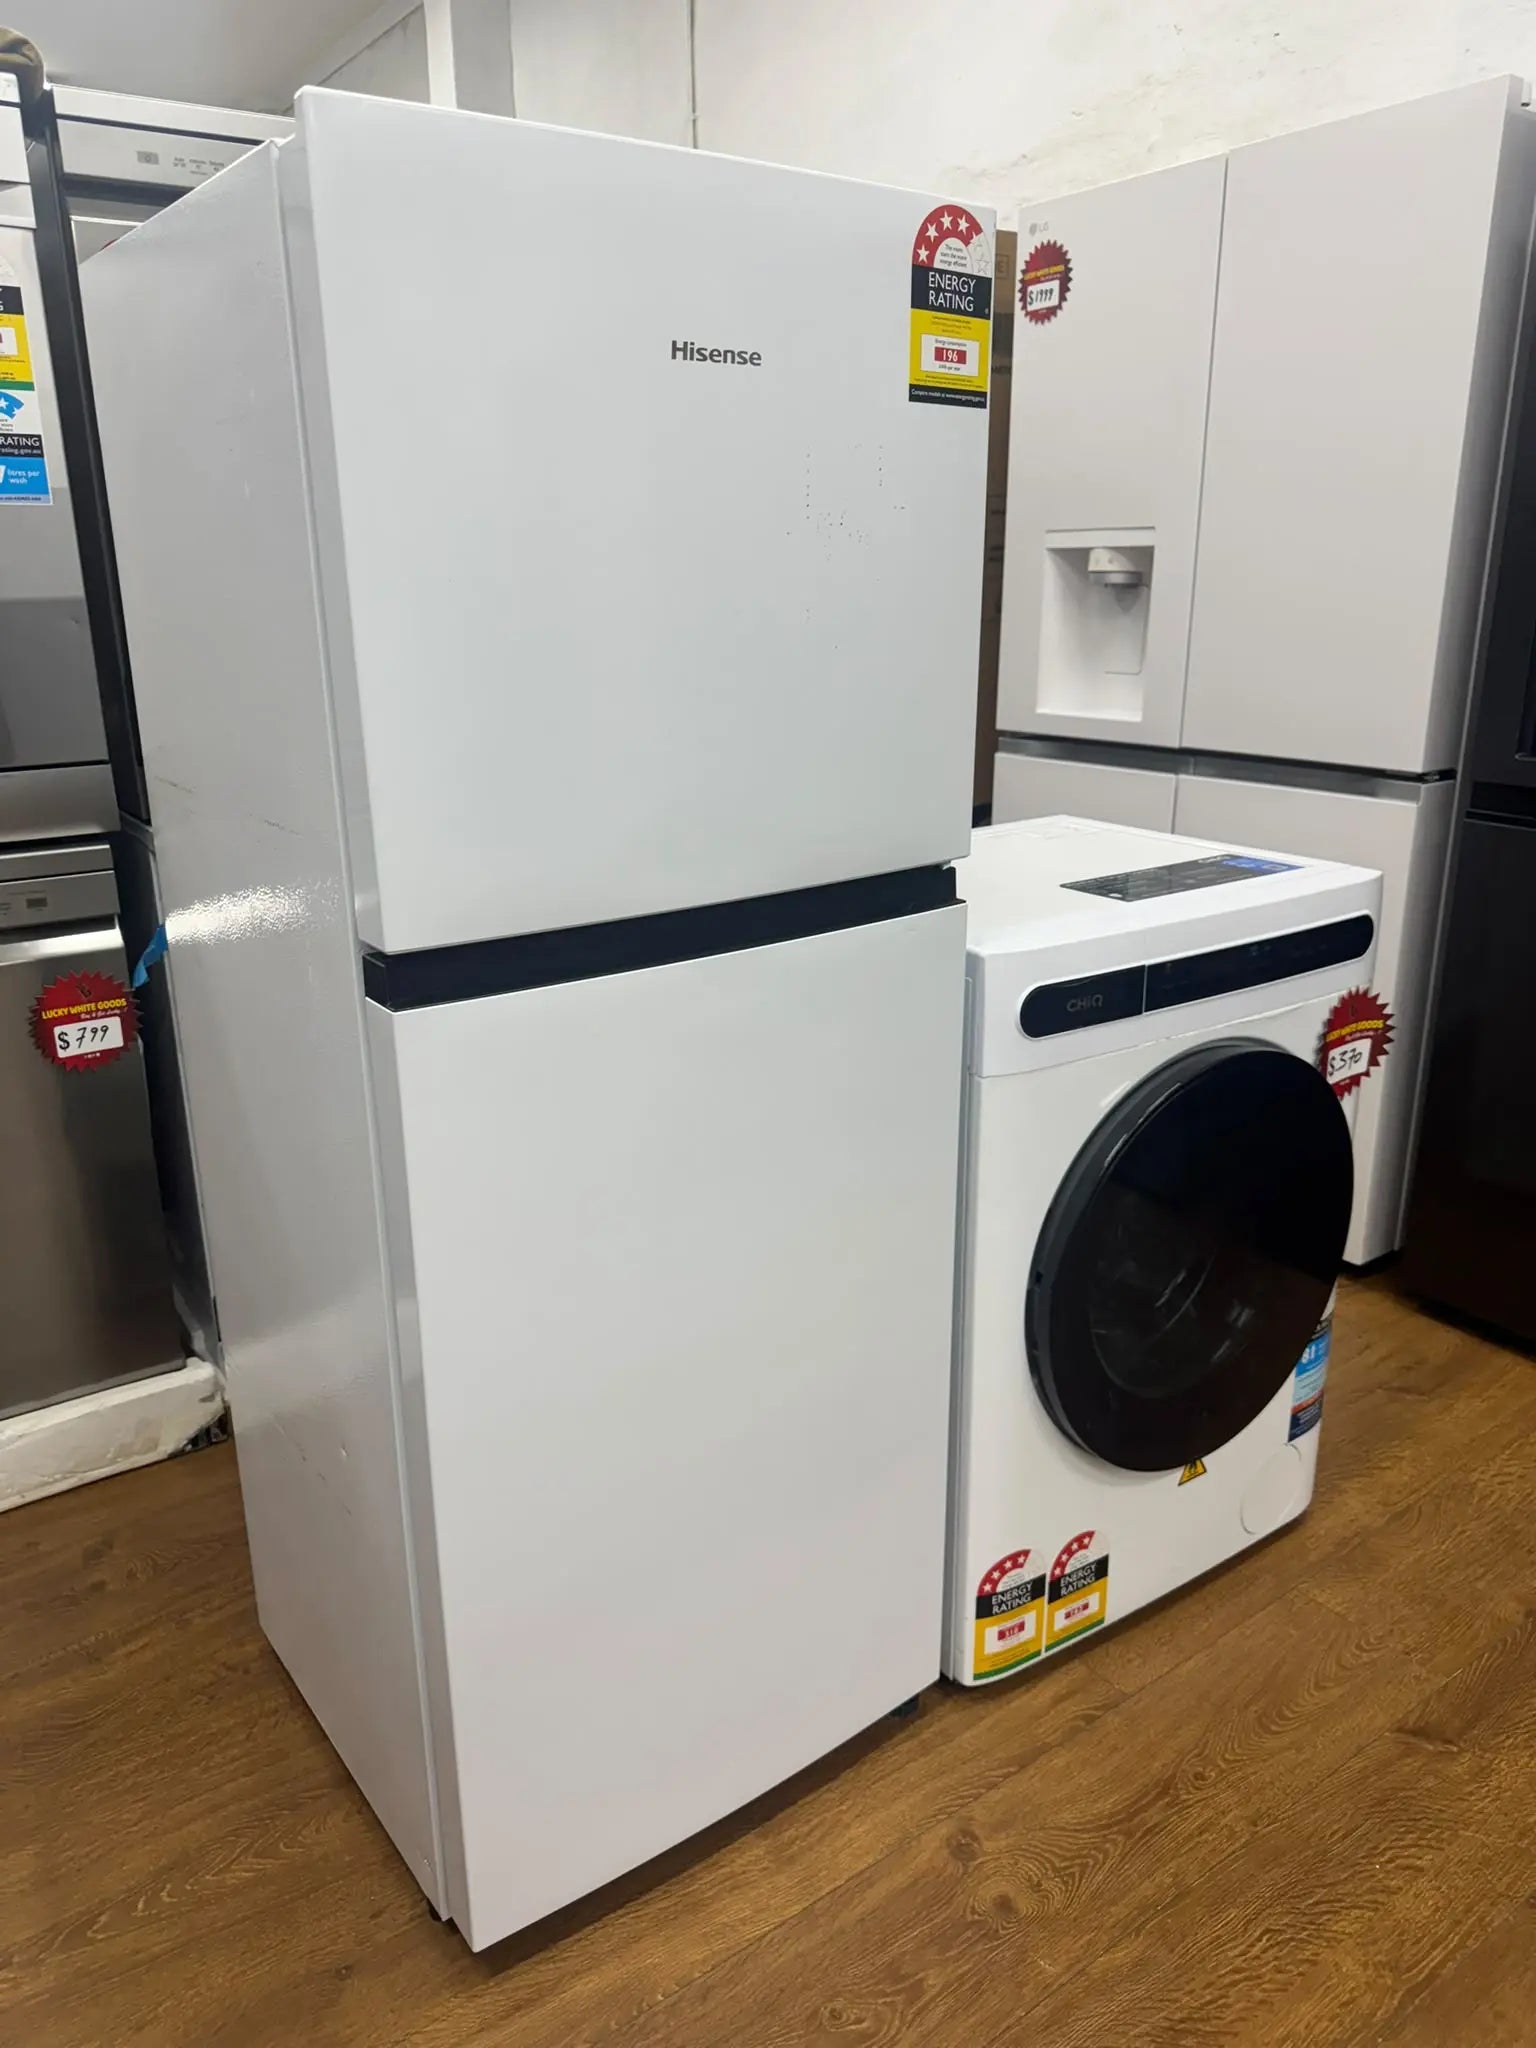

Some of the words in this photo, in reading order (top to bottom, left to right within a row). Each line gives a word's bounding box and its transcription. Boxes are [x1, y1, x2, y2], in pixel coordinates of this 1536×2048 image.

[929, 272, 976, 294] ENERGY
[929, 290, 974, 312] RATING
[671, 340, 762, 366] Hisense
[943, 349, 958, 362] 196
[42, 1007, 69, 1019] LUCKY
[70, 1002, 96, 1014] WHITE
[97, 998, 127, 1010] GOODS
[1060, 1563, 1097, 1587] ENERGY
[1061, 1573, 1095, 1597] RATING
[991, 1581, 1032, 1604] ENERGY
[992, 1594, 1031, 1615] RATING
